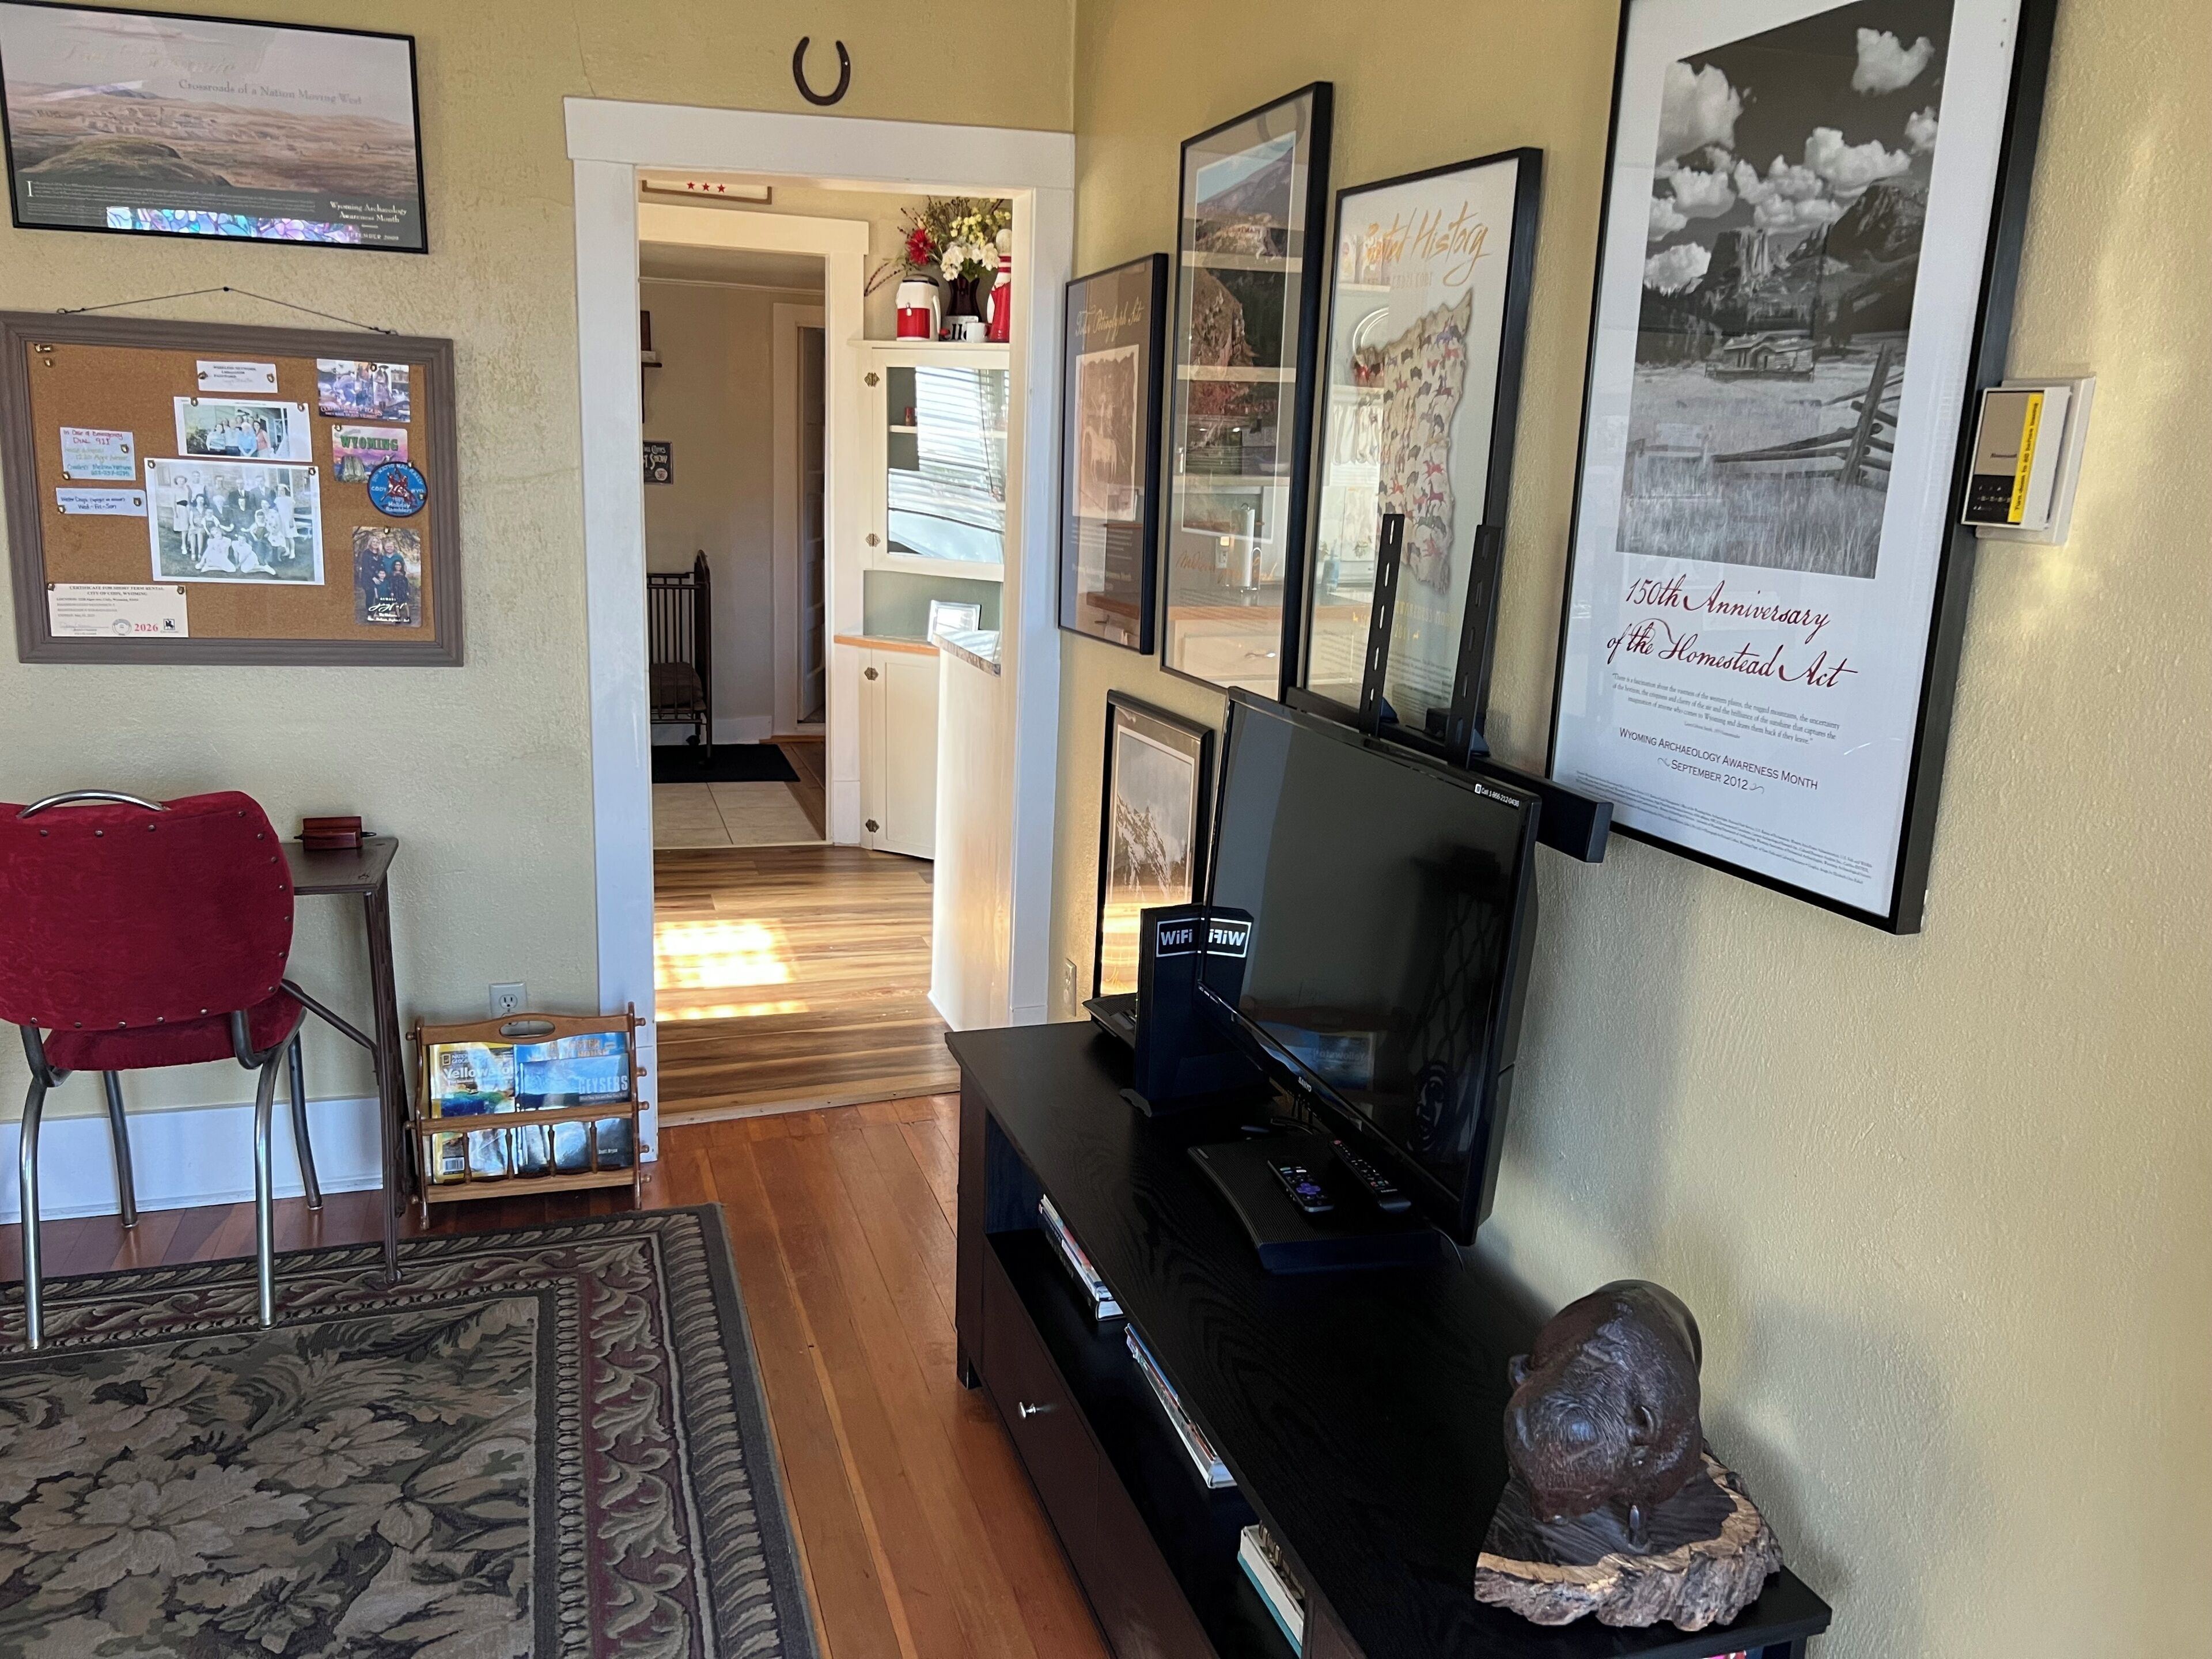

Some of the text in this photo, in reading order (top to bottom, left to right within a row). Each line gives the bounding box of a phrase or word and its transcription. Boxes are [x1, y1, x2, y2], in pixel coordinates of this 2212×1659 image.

[179, 79, 234, 93] Crossroads
[238, 84, 248, 94] of
[259, 86, 295, 99] Nation
[298, 89, 336, 103] Moving
[339, 93, 362, 105] West
[330, 201, 407, 215] Wyoming Archaeology
[340, 211, 399, 223] Awareness Month
[1410, 200, 1492, 286] History
[96, 438, 111, 446] 911
[340, 435, 398, 451] WYOMING
[1626, 573, 1831, 644] 150th Anniversary
[1607, 621, 1858, 688] of the Homestead Act
[1722, 707, 1730, 715] the
[1793, 723, 1803, 732] that
[1804, 729, 1825, 737] captures
[1827, 731, 1836, 740] the
[1800, 714, 1808, 722] the
[1782, 731, 1793, 740] they
[1619, 728, 1657, 746] WYOMING
[1658, 738, 1721, 763] ARCHAEOLOGY
[1722, 755, 1779, 779] AWARENESS
[1781, 770, 1819, 790] MONTH
[1671, 759, 1748, 790] SEPTEMBER 2012
[1481, 787, 1489, 796] Call
[1160, 929, 1193, 946] WiFi
[578, 1075, 628, 1094] GEYSERS
